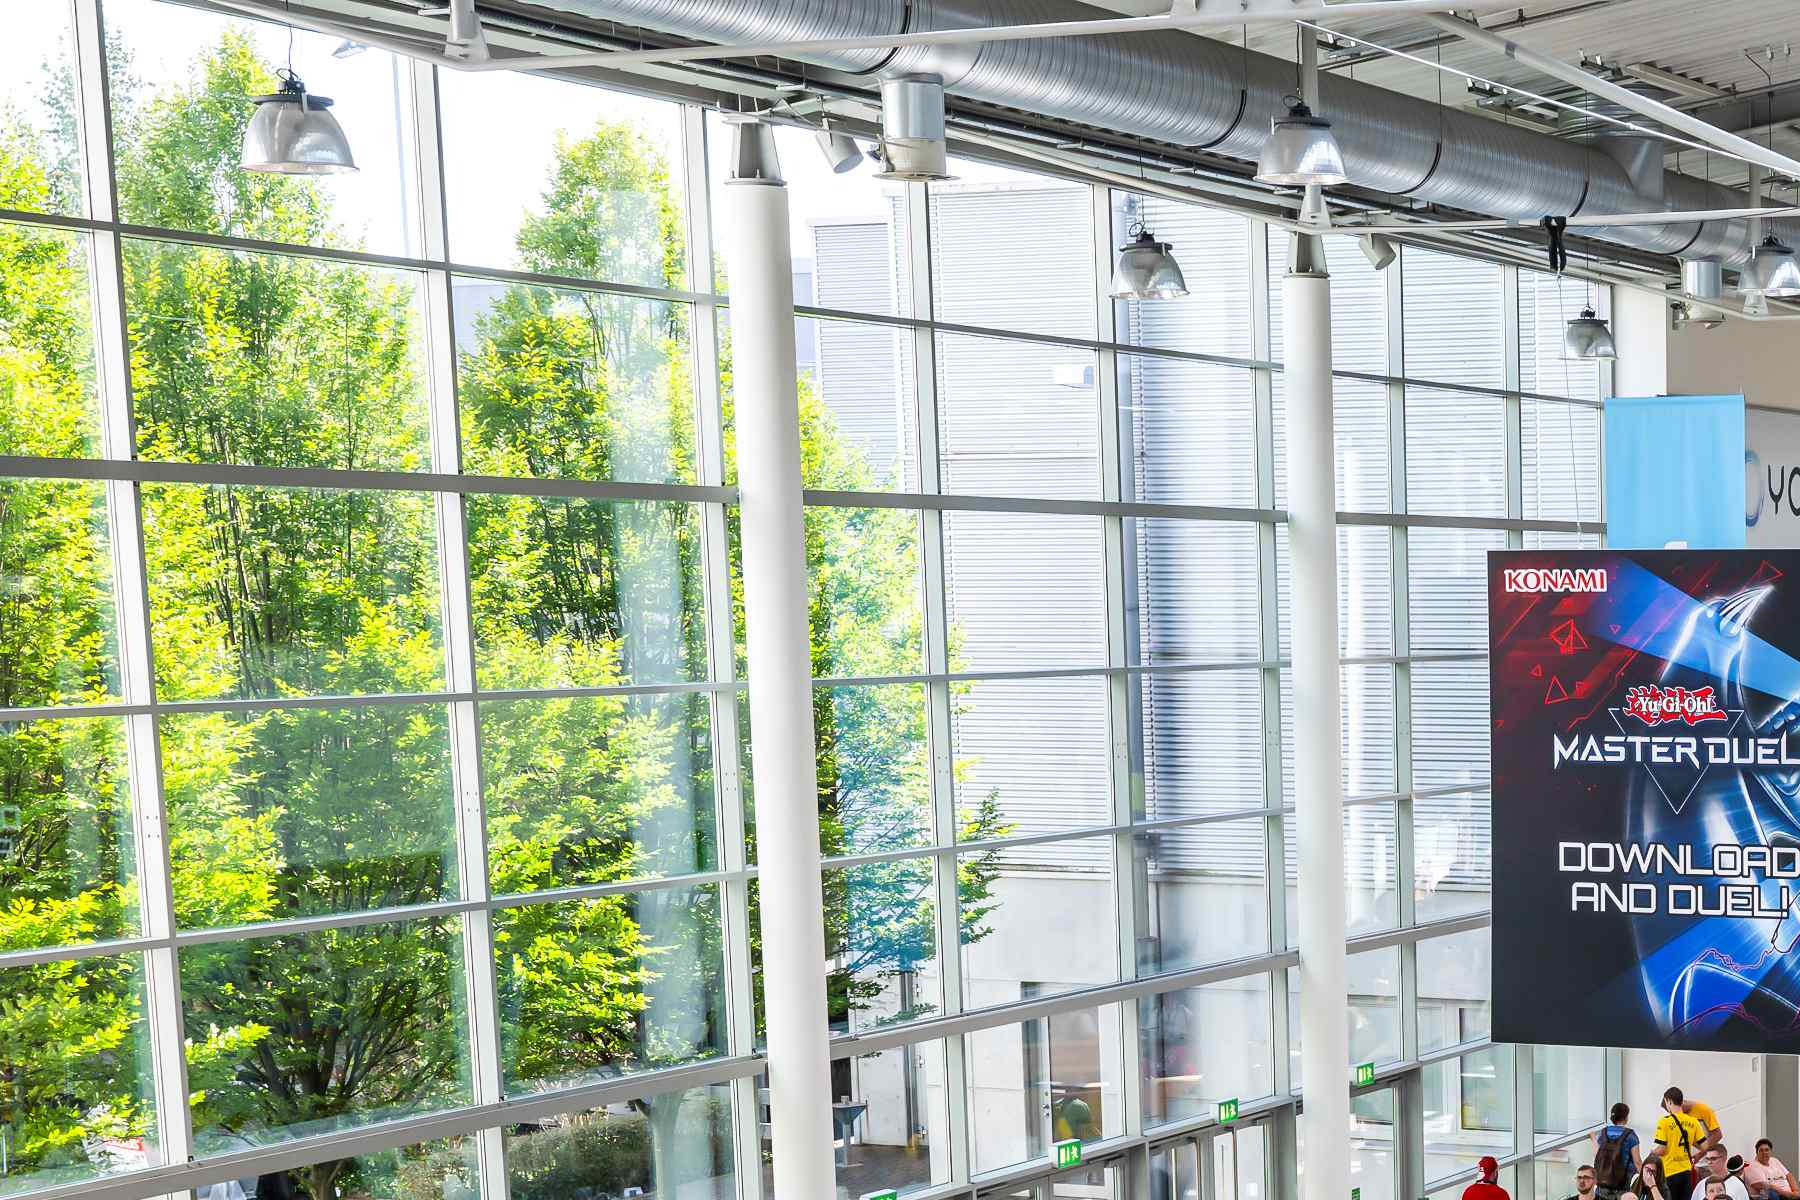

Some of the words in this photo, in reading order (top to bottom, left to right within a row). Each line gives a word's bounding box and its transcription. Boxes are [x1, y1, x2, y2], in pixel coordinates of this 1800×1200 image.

[1504, 568, 1607, 592] KONAMI
[1637, 695, 1713, 713] Yu-Gi-Oh!
[1553, 733, 1700, 770] MASTER
[1558, 841, 1800, 879] DOWNLOAD
[1571, 882, 1657, 914] AND
[1667, 884, 1790, 919] DUEL!
